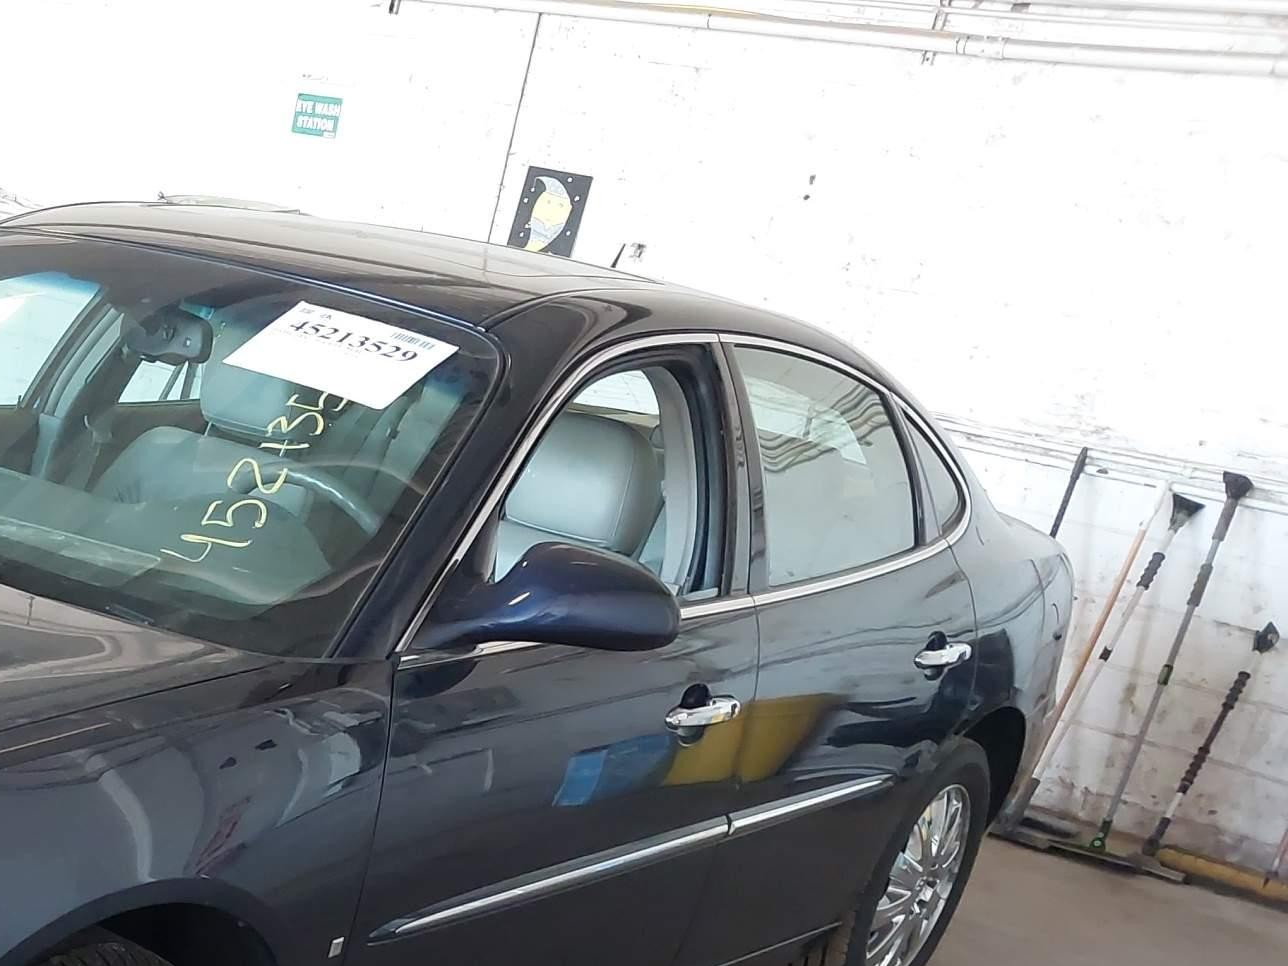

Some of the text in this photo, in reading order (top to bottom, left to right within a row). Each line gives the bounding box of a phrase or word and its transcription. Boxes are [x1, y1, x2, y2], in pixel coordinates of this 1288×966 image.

[295, 99, 341, 117] EYE WASH
[296, 114, 335, 132] STATION
[290, 320, 418, 362] 45213529
